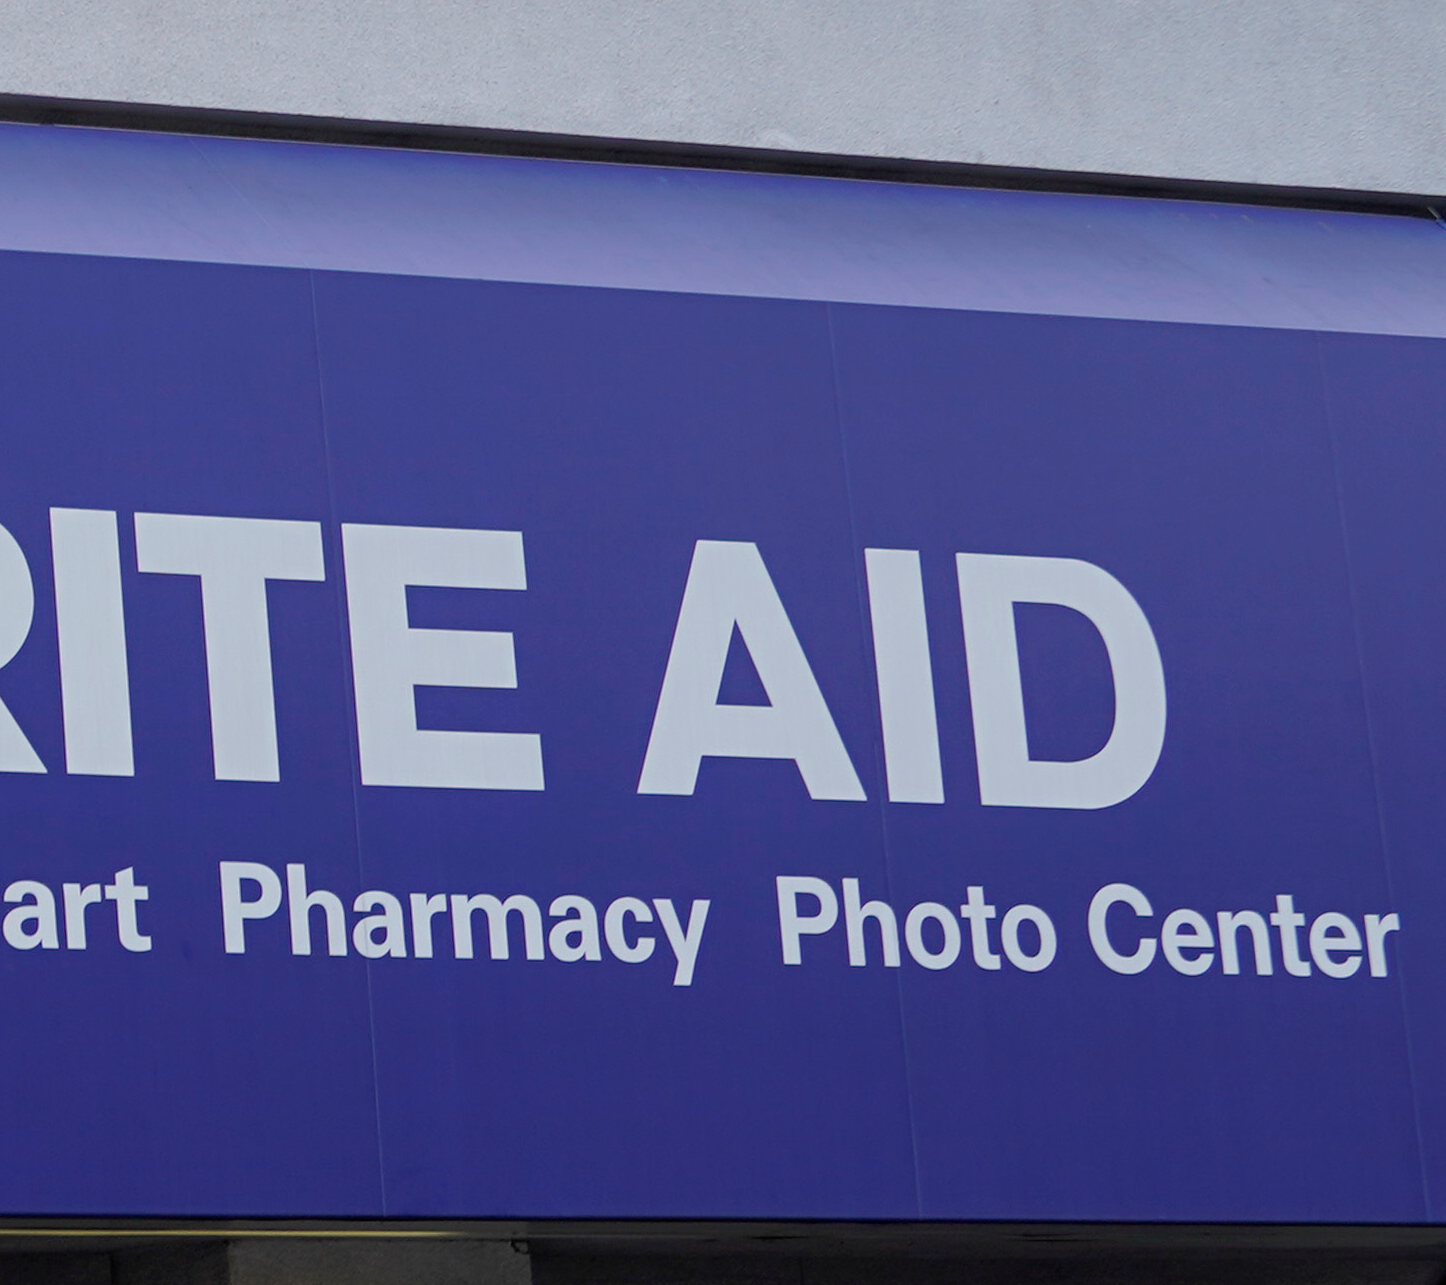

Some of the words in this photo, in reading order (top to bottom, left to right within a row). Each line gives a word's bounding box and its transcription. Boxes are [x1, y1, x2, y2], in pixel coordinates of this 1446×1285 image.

[636, 540, 1166, 810] AID
[219, 861, 711, 987] Pharmacy
[775, 876, 1057, 974] Photo
[1087, 883, 1400, 978] Center
